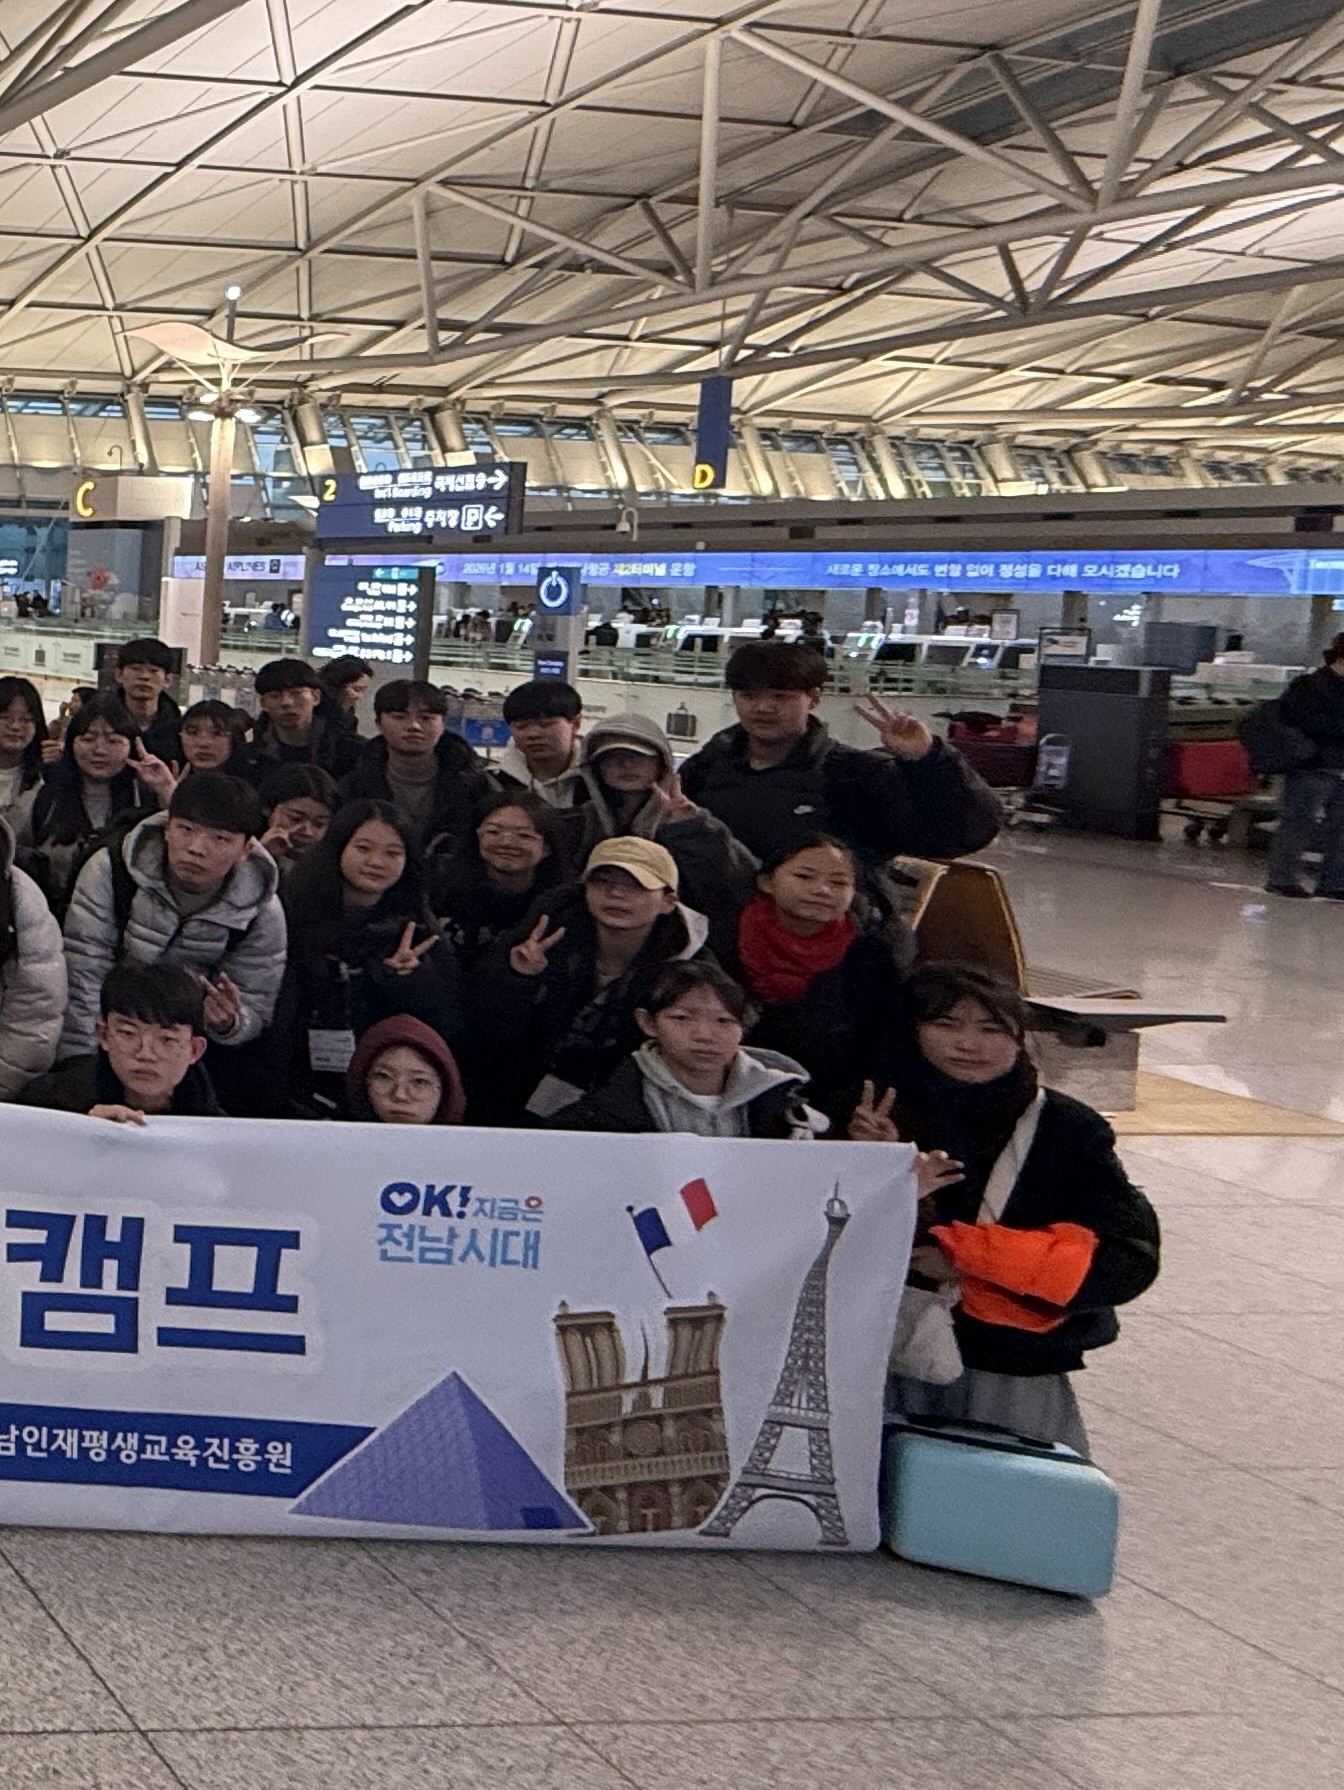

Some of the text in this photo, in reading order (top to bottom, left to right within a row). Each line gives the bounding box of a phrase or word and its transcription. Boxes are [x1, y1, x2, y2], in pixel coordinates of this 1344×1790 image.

[323, 479, 337, 501] 2
[694, 463, 715, 489] D
[76, 481, 95, 517] C
[379, 1181, 545, 1223] OK! 지금은
[376, 1221, 542, 1270] 전남시대
